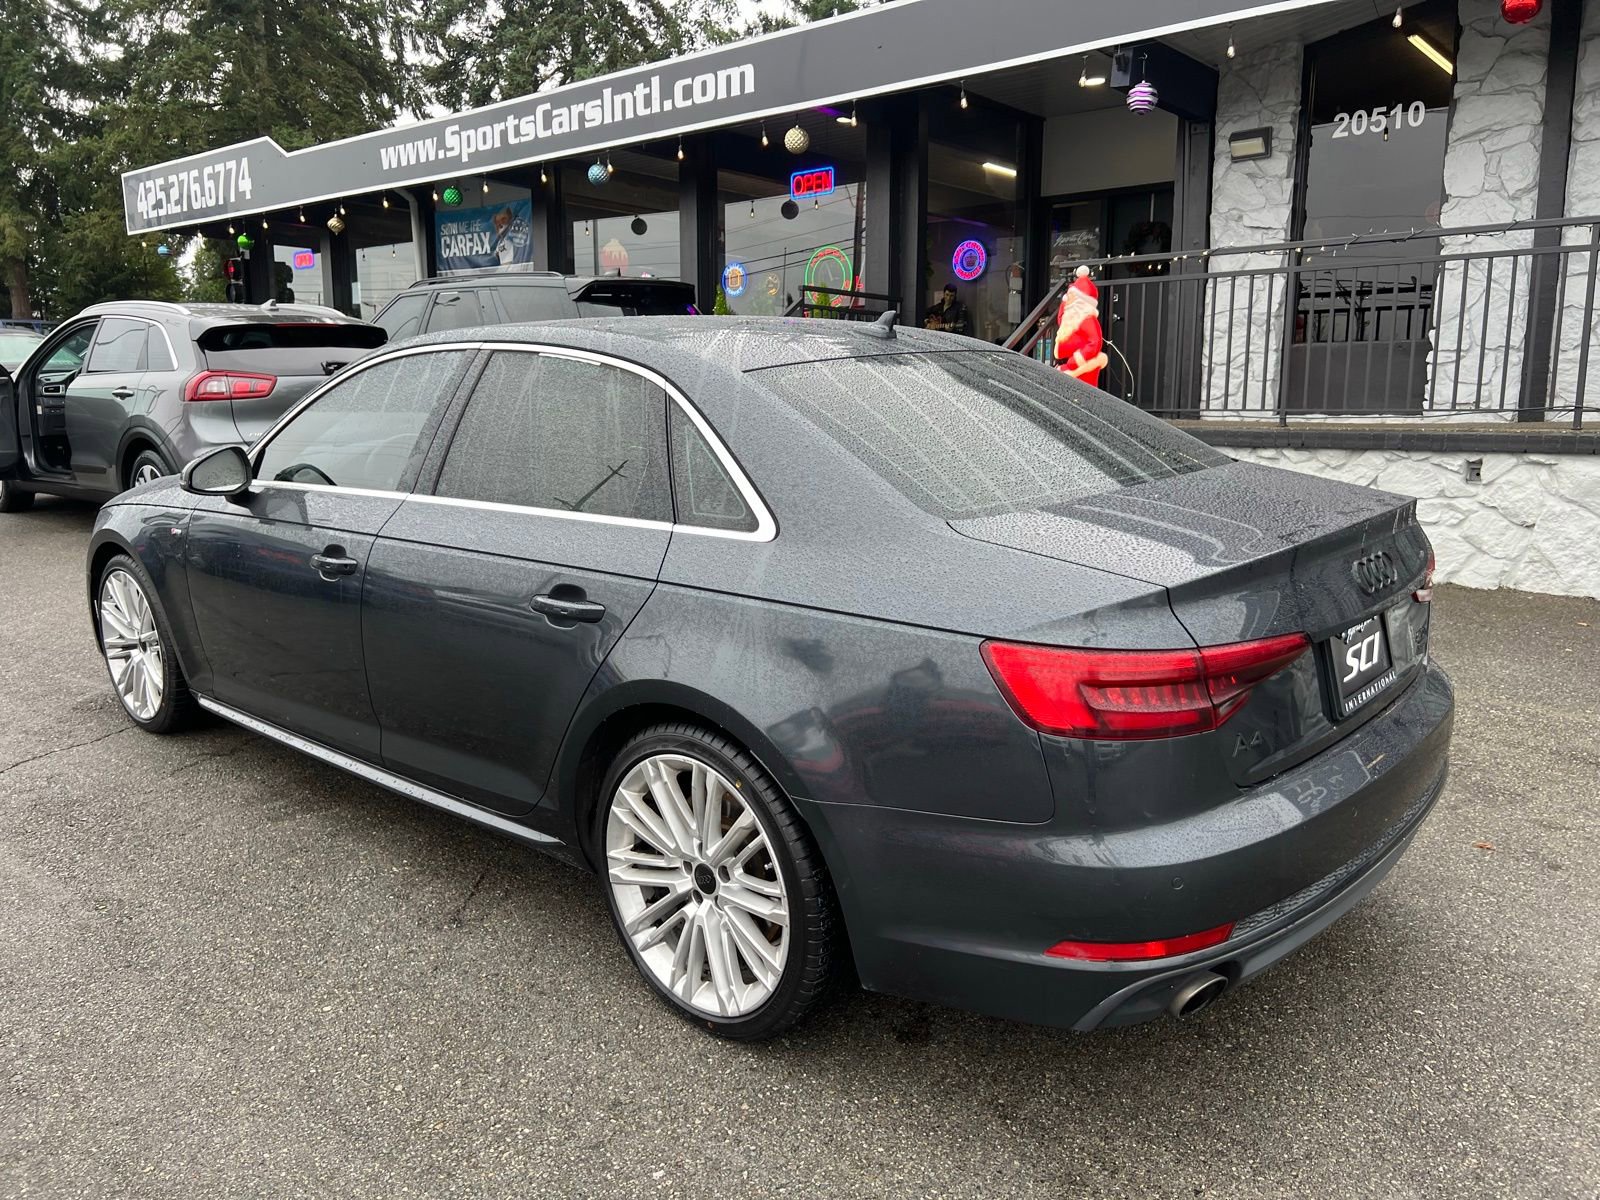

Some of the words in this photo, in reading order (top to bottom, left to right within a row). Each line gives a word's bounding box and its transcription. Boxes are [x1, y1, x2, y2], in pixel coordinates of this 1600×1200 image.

[379, 62, 755, 171] www.SportsCarsIntl.com
[1332, 101, 1425, 138] 20510
[137, 157, 252, 219] 425.276.6774
[793, 170, 833, 196] OPEN
[441, 231, 491, 258] CARFAX
[1343, 631, 1380, 683] SCI
[1344, 670, 1397, 713] INTERNATIONAL
[1232, 730, 1262, 757] A4
